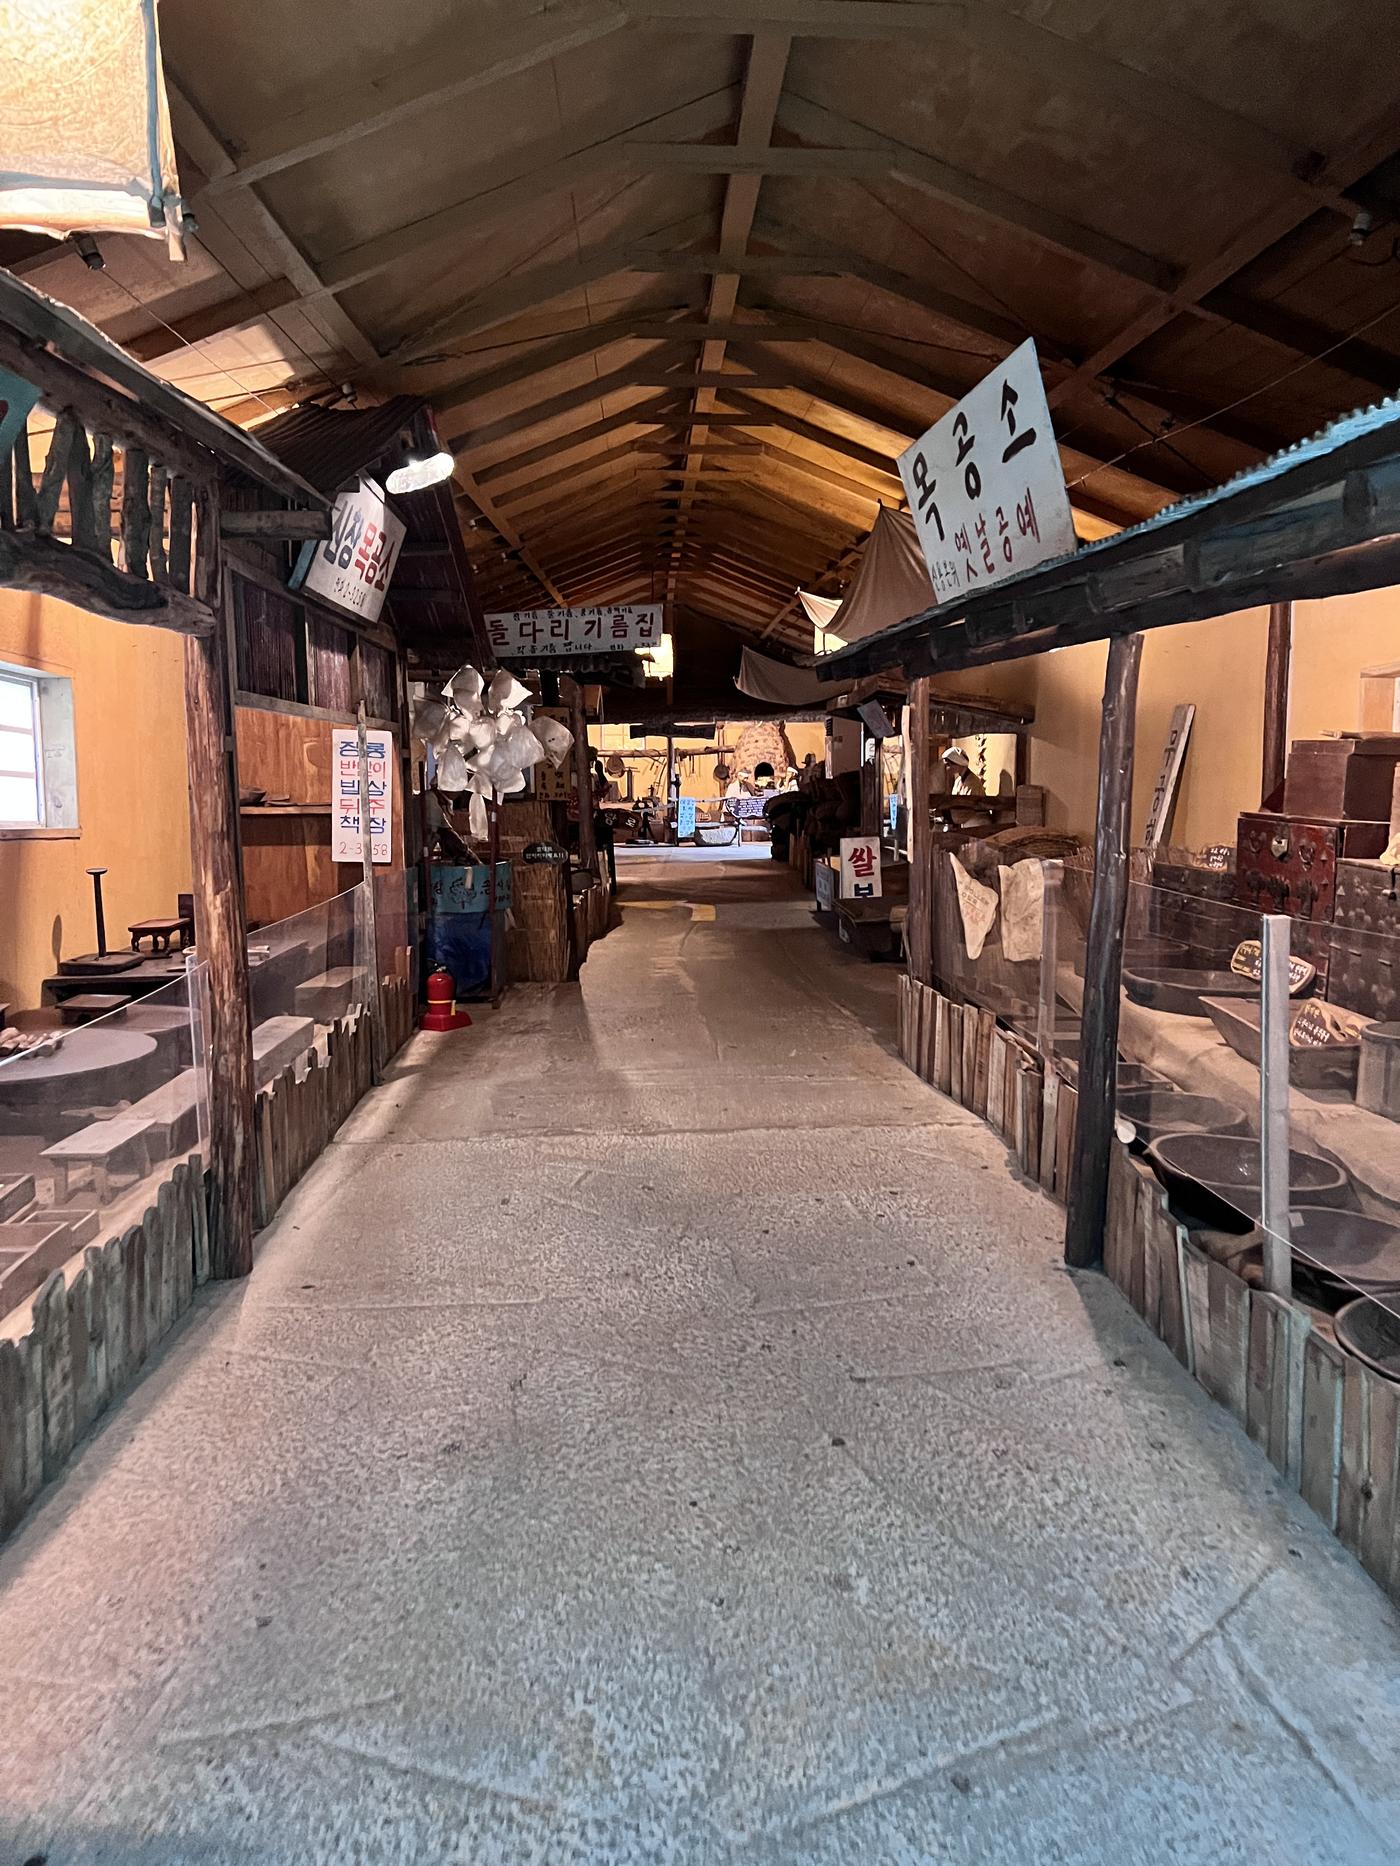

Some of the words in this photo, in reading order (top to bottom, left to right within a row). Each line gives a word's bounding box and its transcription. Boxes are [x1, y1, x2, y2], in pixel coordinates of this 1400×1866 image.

[912, 378, 1037, 541] 목공소
[340, 798, 385, 815] 뒤주
[340, 815, 387, 834] 책장
[340, 842, 388, 856] 2-358
[848, 845, 877, 878] 쌀
